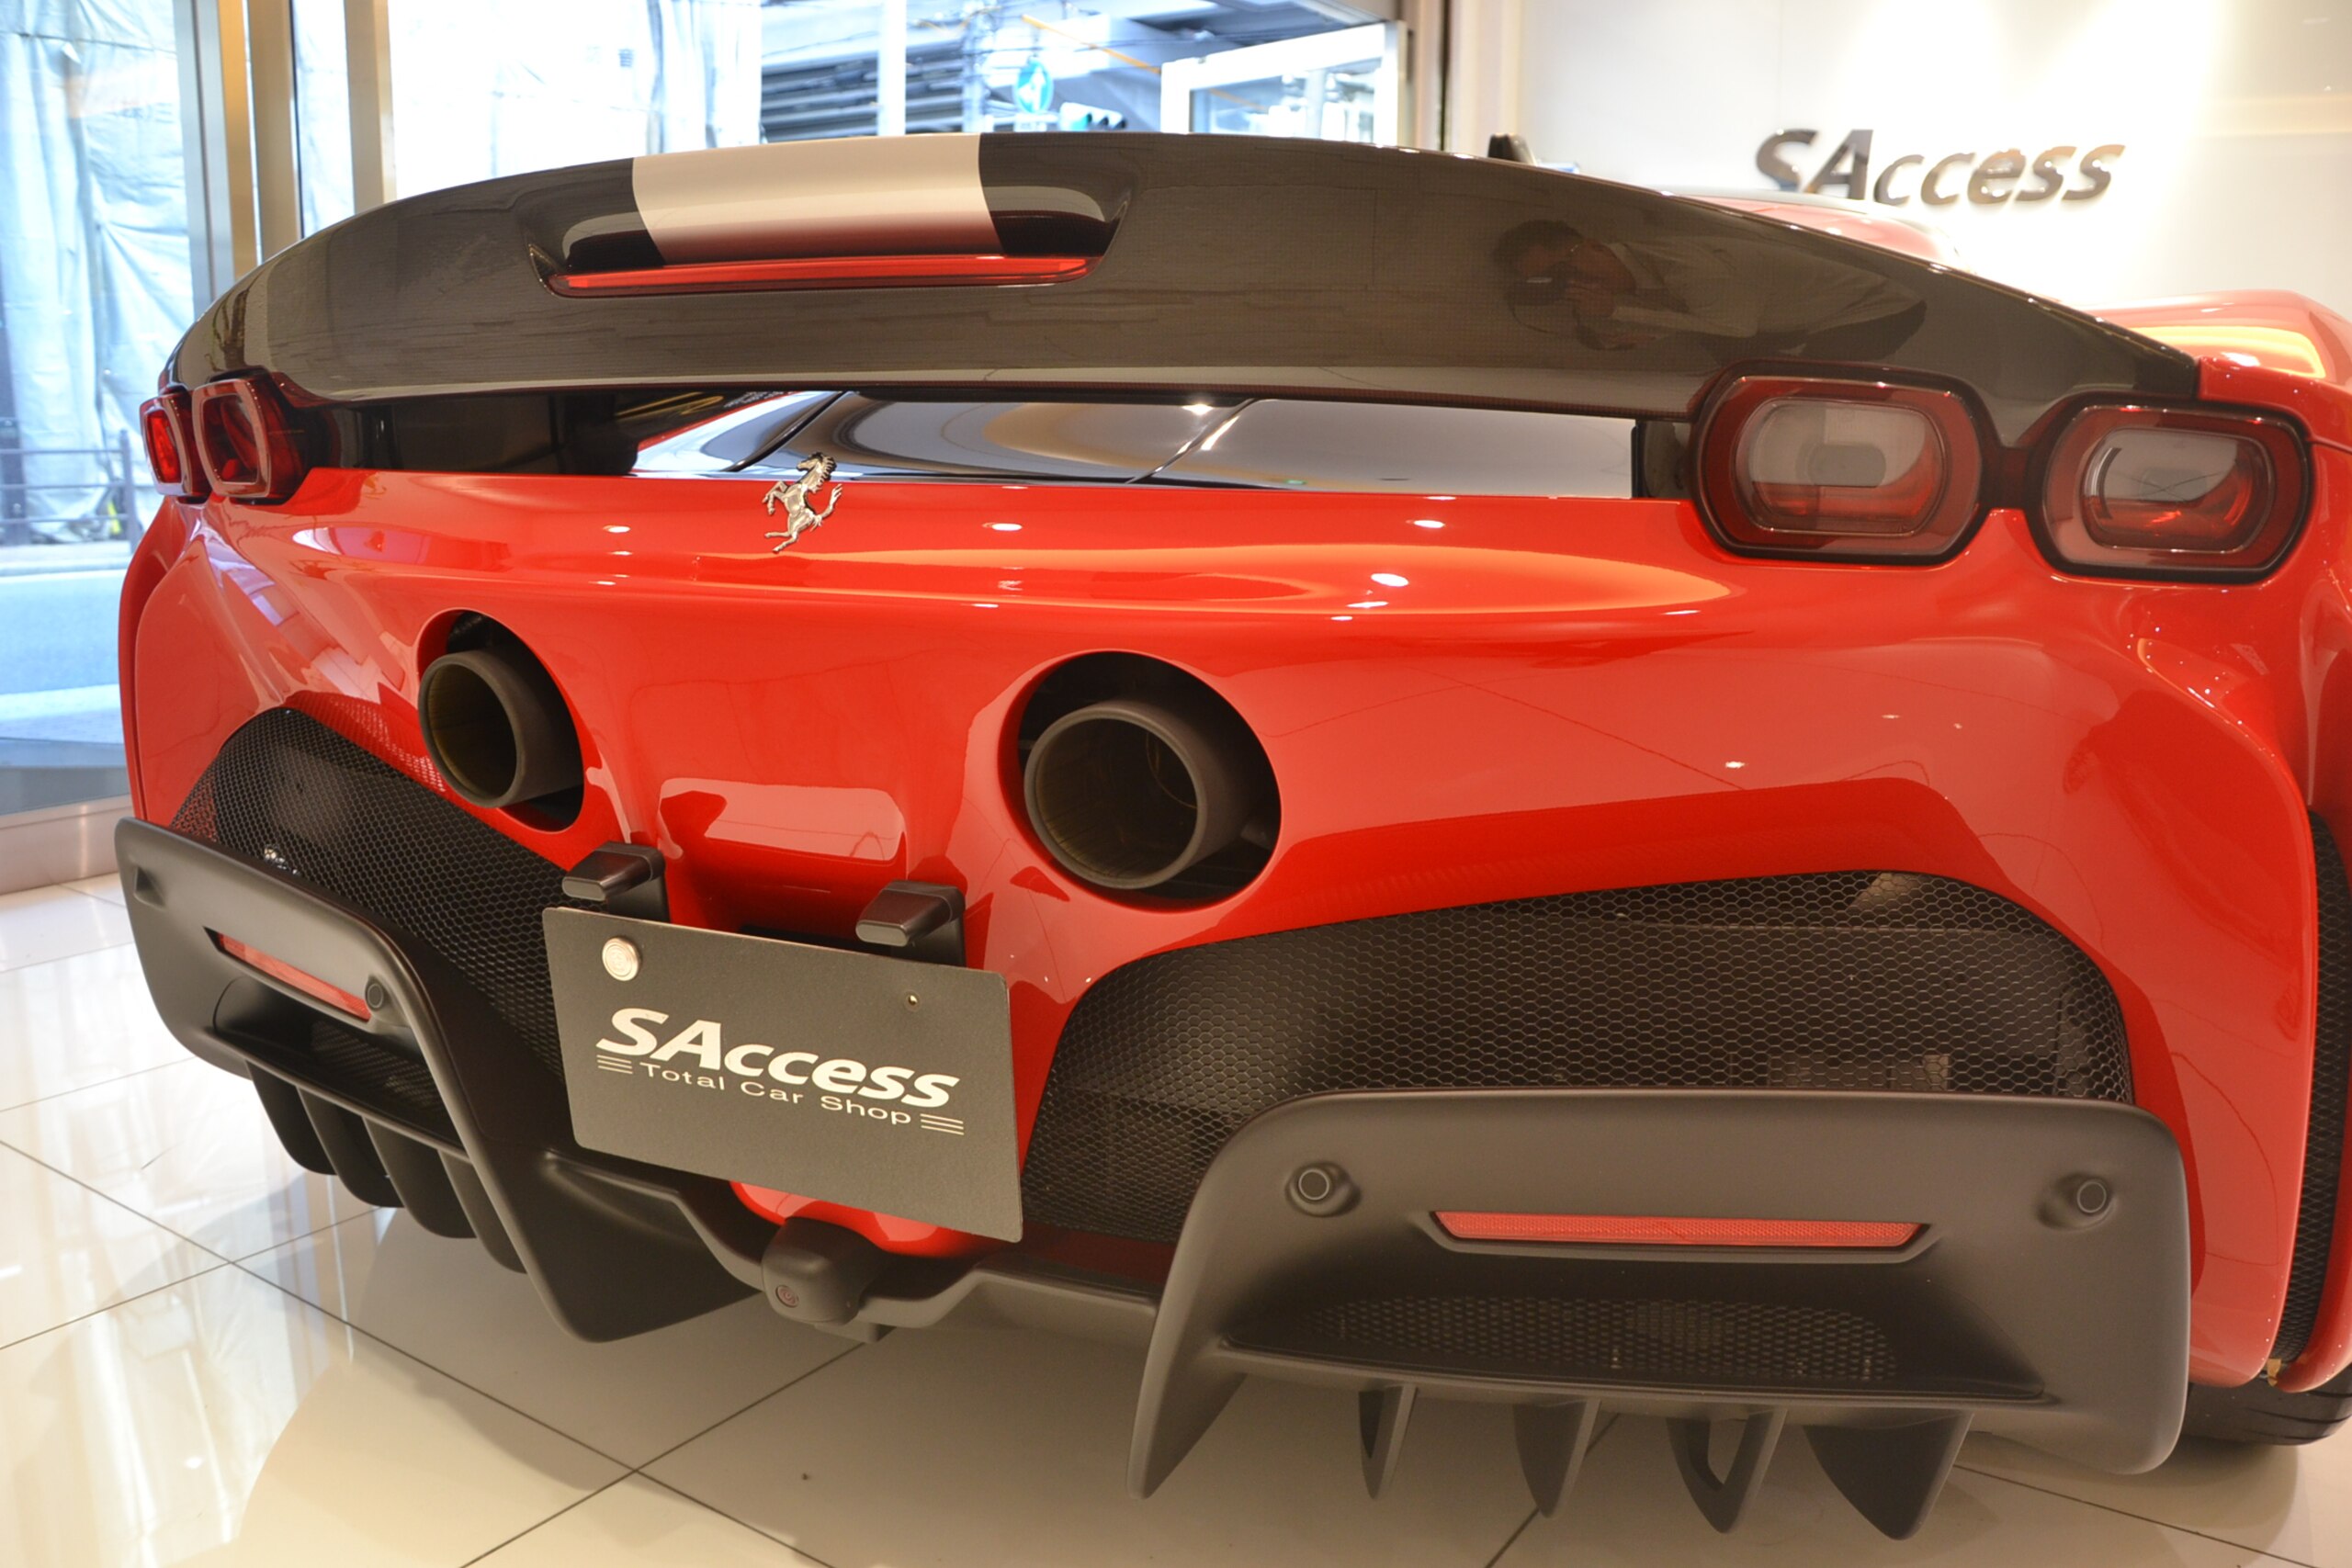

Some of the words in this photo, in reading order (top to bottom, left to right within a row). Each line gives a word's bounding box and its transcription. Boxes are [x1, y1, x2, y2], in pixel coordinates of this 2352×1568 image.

[1756, 128, 2127, 207] SAccess
[595, 1007, 961, 1109] SAccess
[639, 1061, 726, 1091] Total
[740, 1080, 804, 1105] Car
[820, 1095, 912, 1125] Shop
